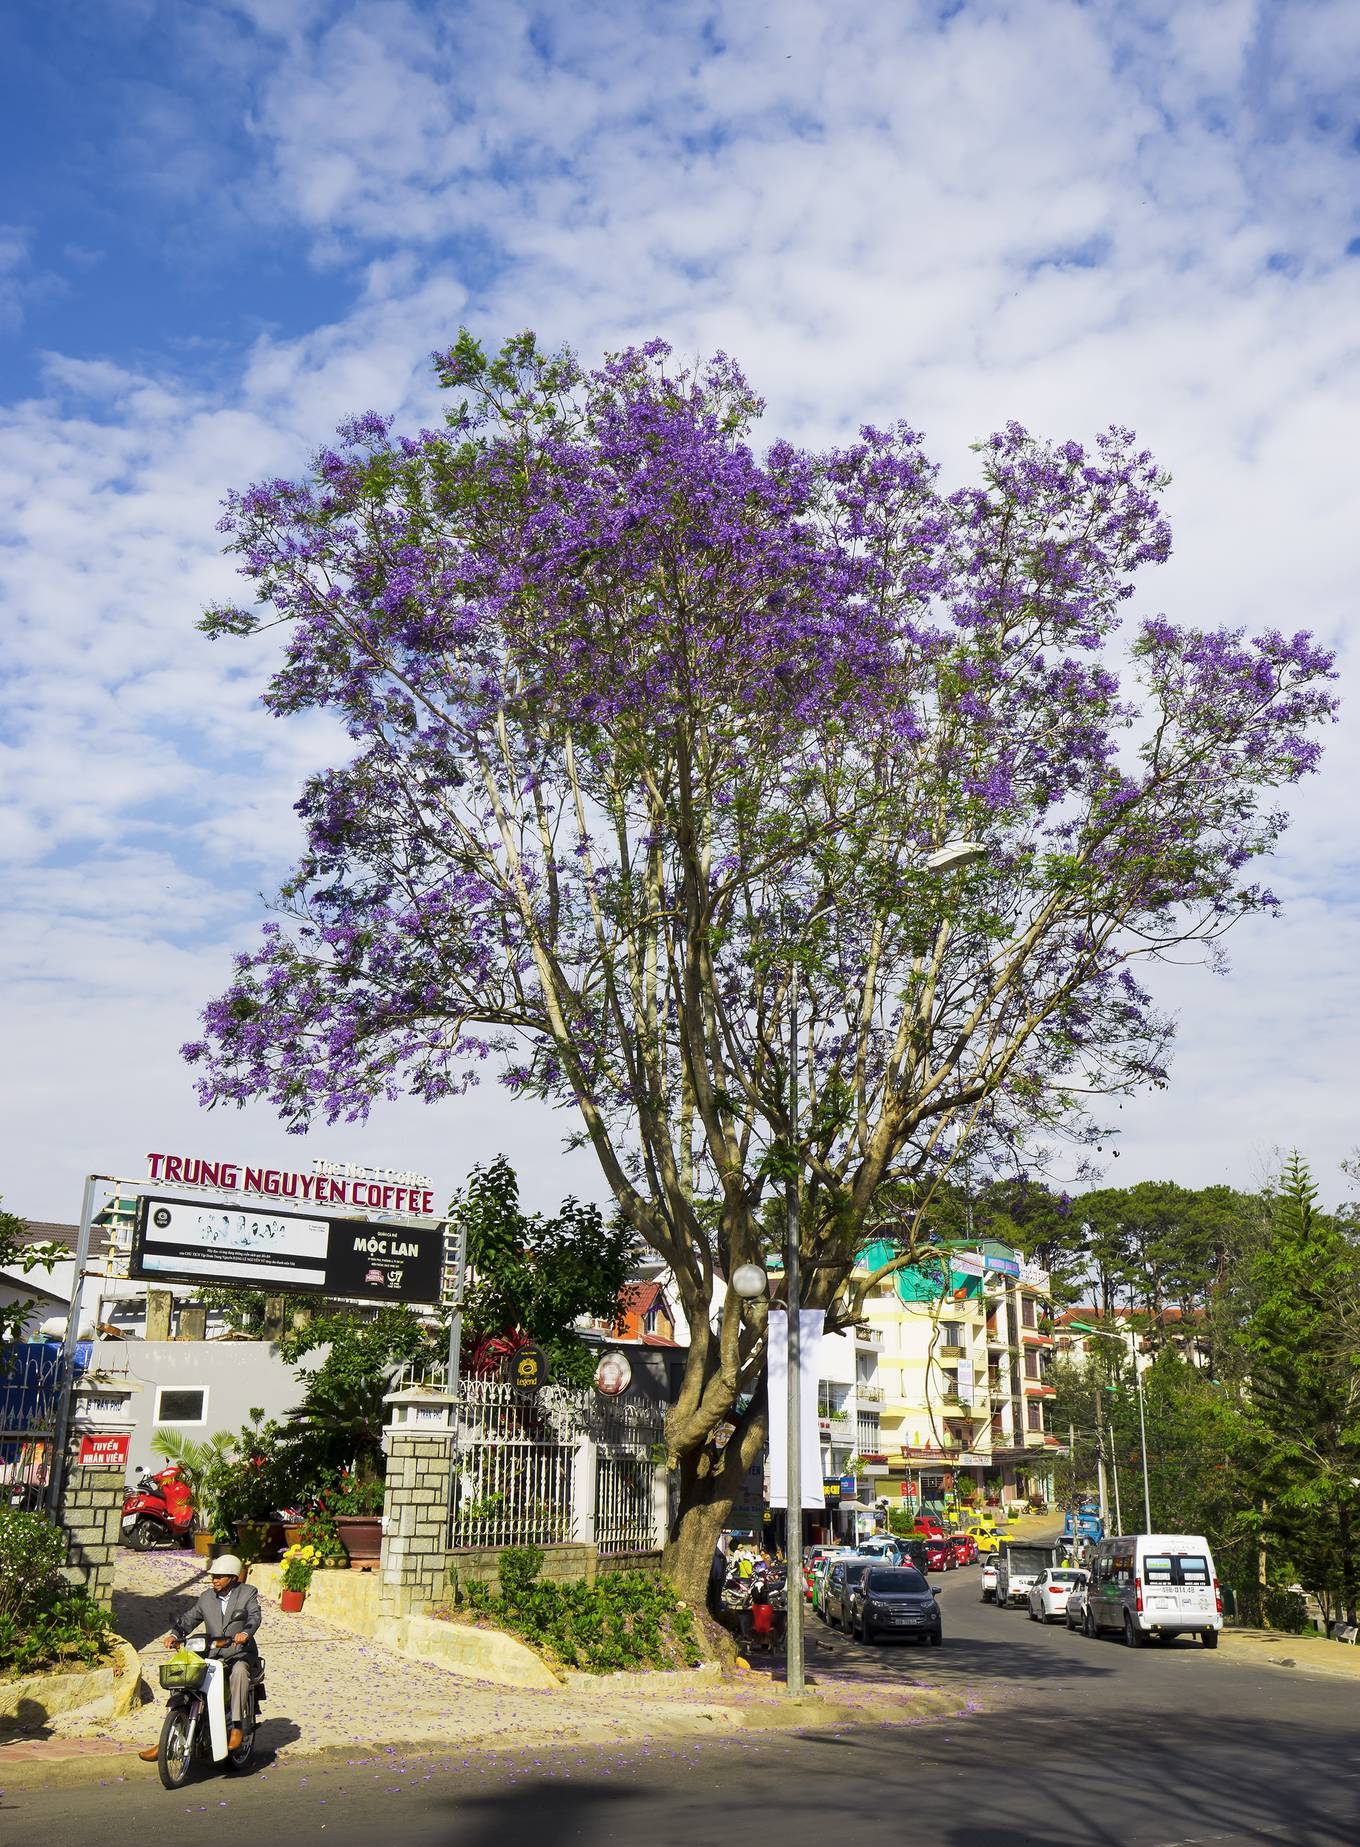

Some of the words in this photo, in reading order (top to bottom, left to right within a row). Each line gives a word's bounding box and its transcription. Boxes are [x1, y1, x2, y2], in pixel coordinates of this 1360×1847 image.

[146, 1153, 238, 1190] TRUNG
[244, 1166, 347, 1204] NGUYÊN
[352, 1182, 434, 1213] COFFEE
[386, 1168, 433, 1189] Coffee
[353, 1236, 387, 1257] MỘC
[391, 1242, 419, 1258] LAN
[516, 1378, 538, 1387] Legend
[105, 1452, 124, 1464] VIÊN
